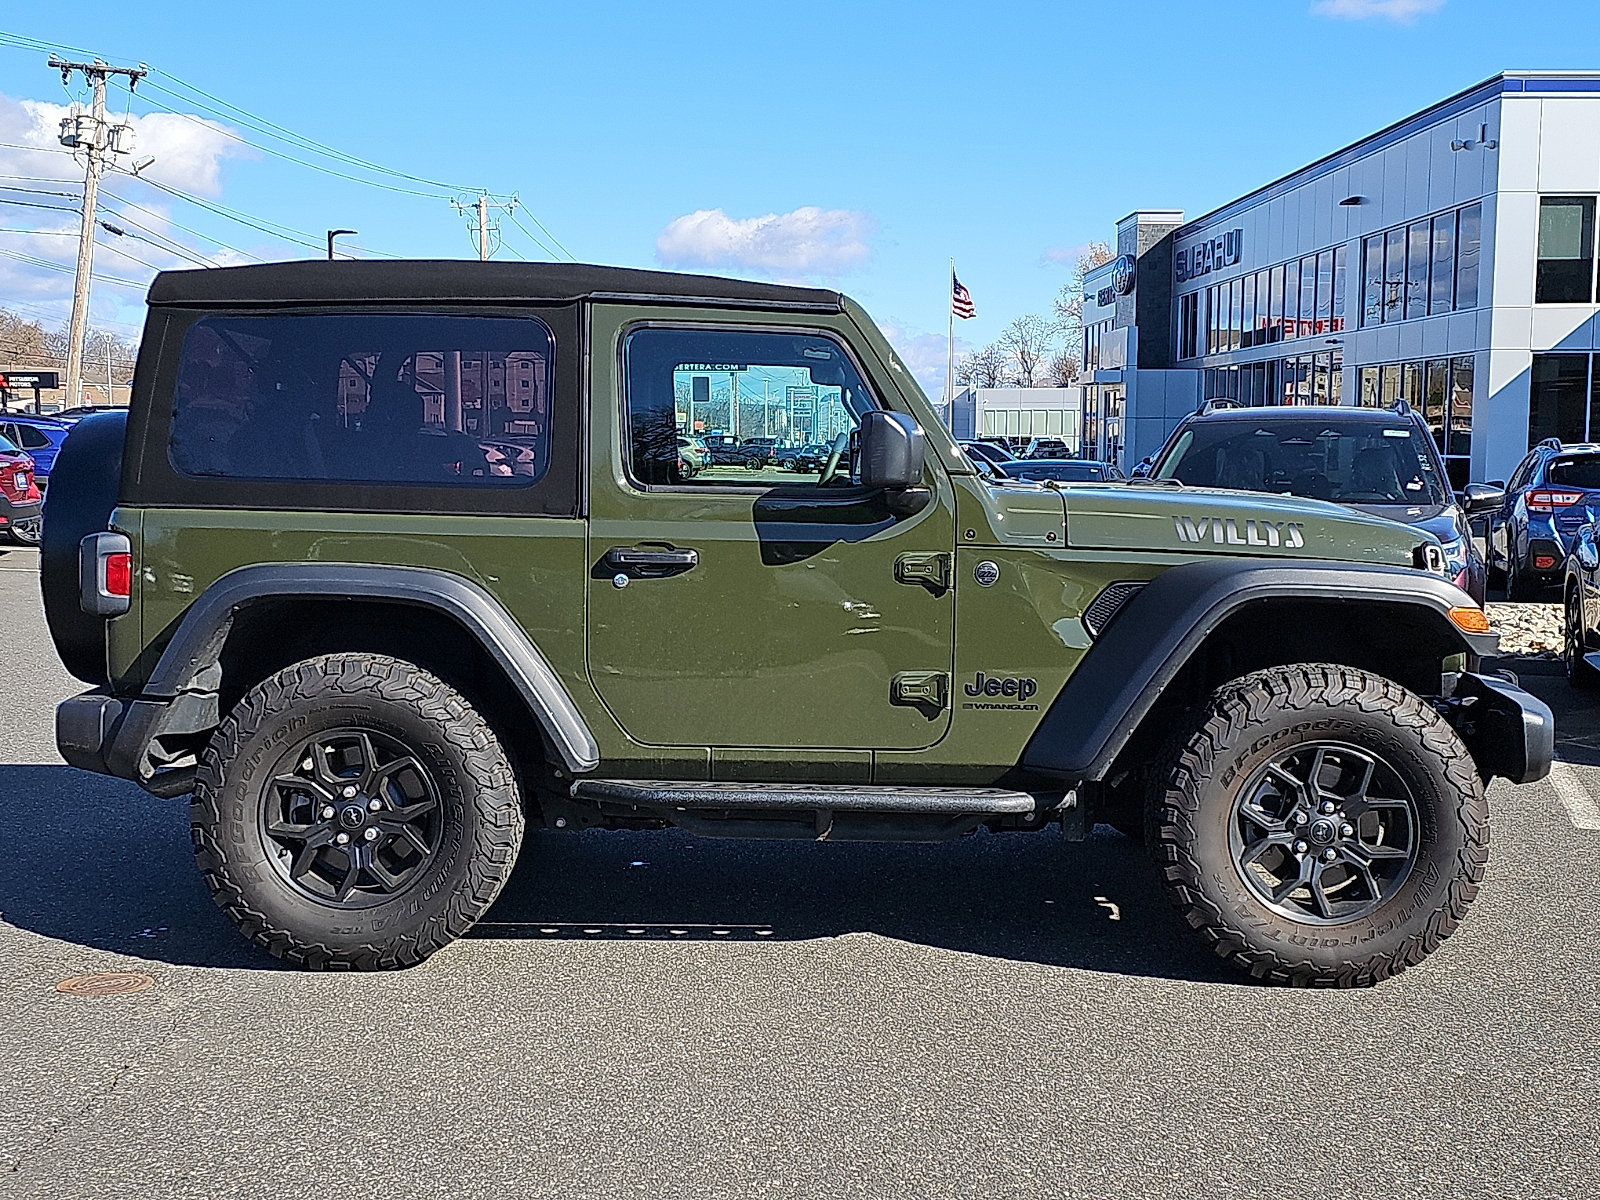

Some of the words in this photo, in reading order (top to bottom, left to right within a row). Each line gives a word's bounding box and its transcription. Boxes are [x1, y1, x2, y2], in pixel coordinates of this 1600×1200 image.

[1175, 229, 1243, 283] SUBARU
[1171, 515, 1305, 548] WILLYS
[964, 672, 1038, 701] Jeep
[974, 703, 1039, 711] WRANGLER
